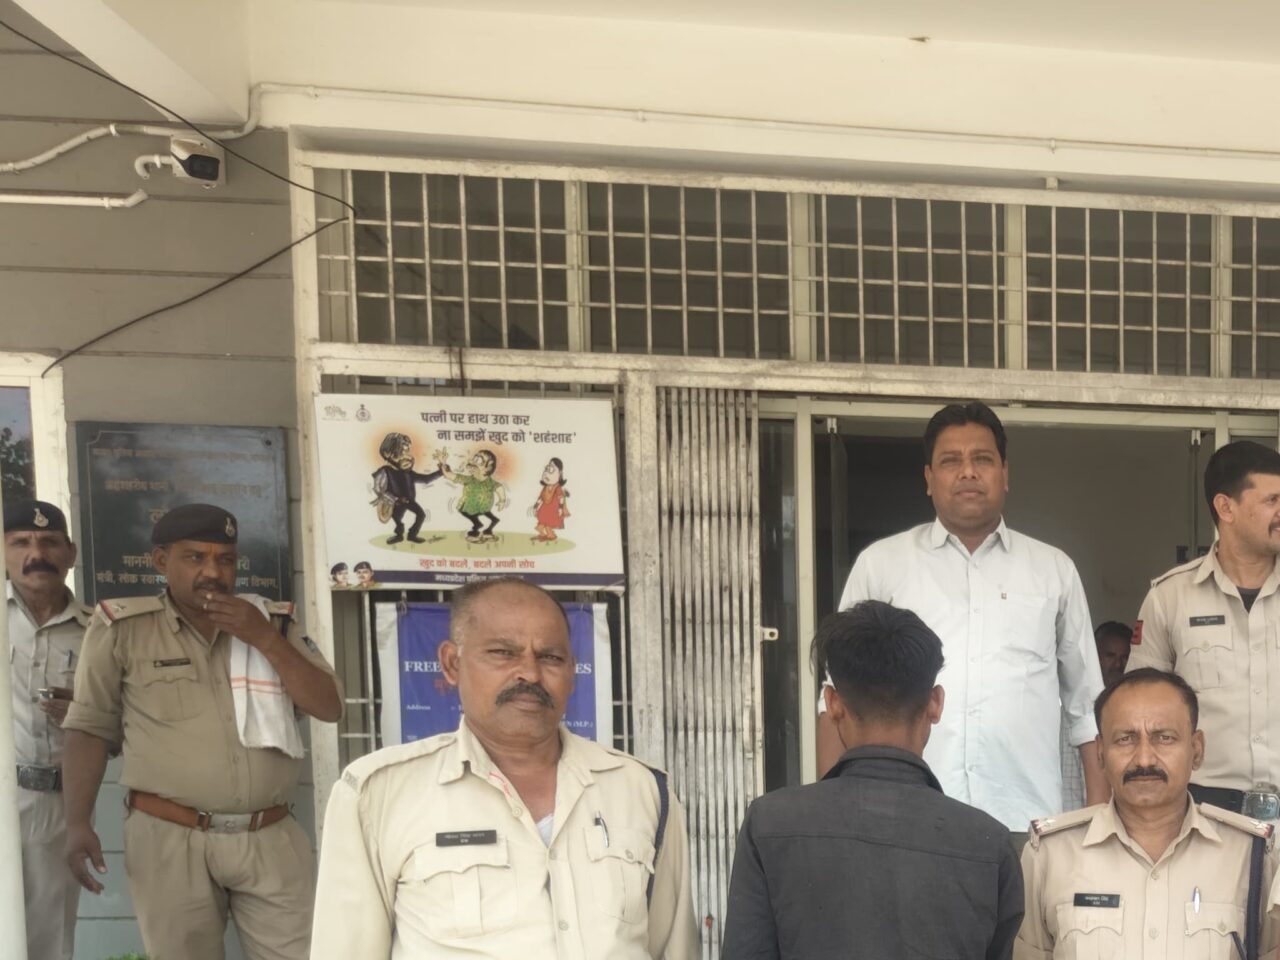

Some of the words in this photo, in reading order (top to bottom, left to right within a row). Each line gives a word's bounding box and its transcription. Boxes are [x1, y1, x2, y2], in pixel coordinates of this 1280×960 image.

[421, 410, 446, 423] पत्नी
[450, 412, 465, 424] पर
[468, 413, 489, 424] हाथ
[492, 414, 510, 426] उठा
[512, 415, 530, 426] कर
[436, 429, 450, 440] ना
[454, 428, 486, 442] समझें
[488, 431, 508, 445] खुद
[511, 430, 526, 443] को
[122, 555, 153, 569] माननी
[404, 661, 441, 672] FREE
